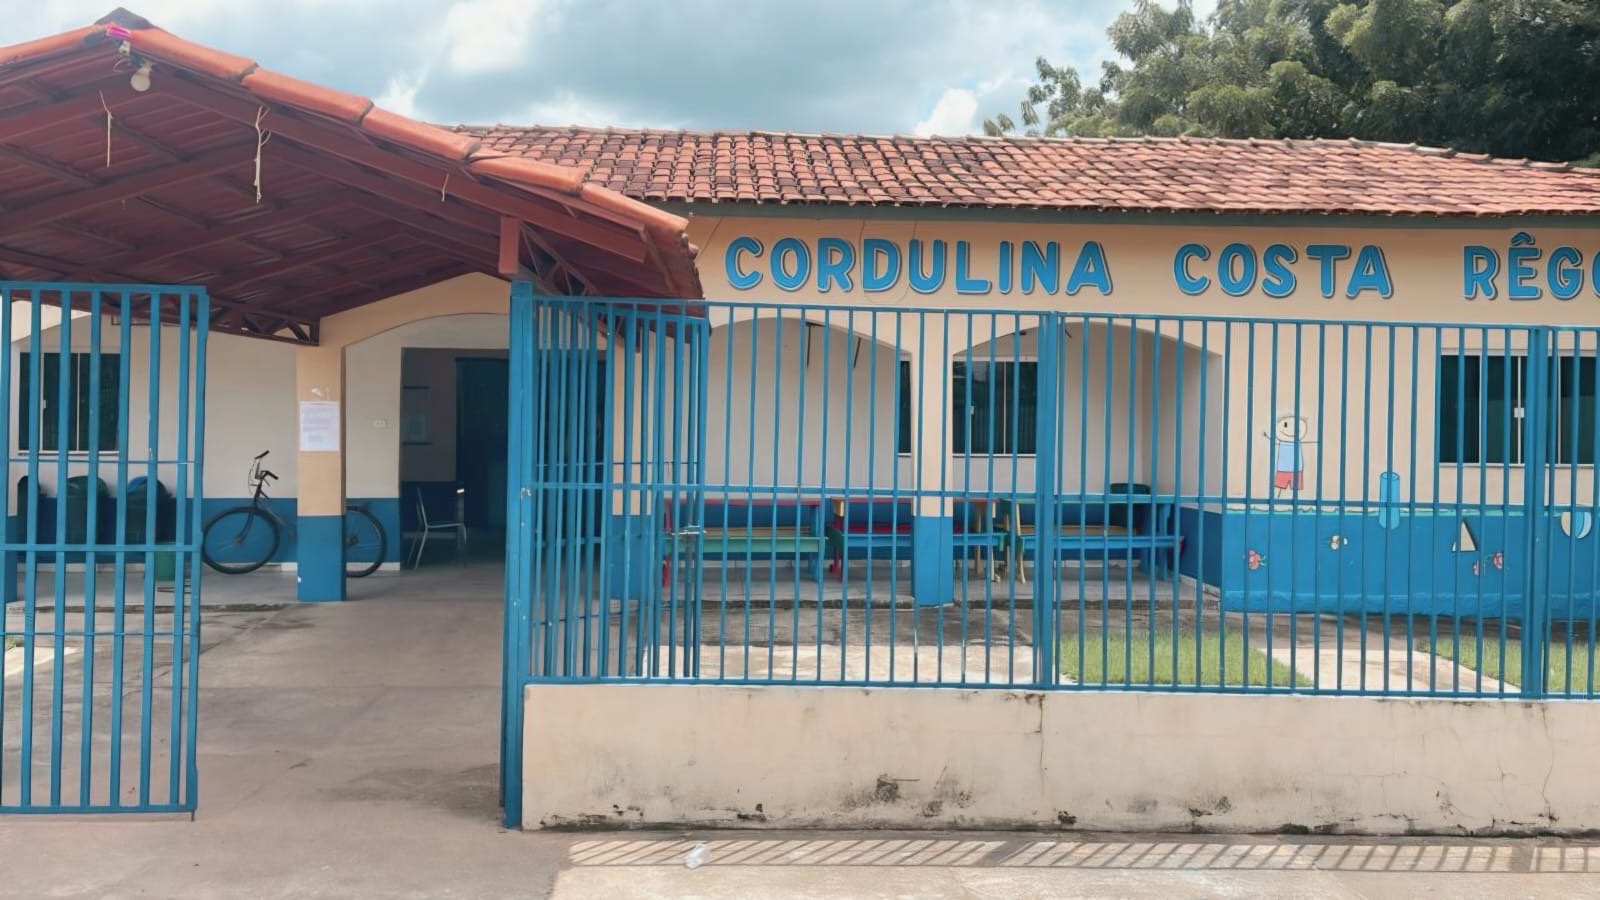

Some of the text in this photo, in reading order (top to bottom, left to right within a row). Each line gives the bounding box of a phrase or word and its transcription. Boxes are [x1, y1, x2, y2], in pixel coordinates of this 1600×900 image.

[724, 231, 1600, 301] CORDULINA COSTA RÊG
